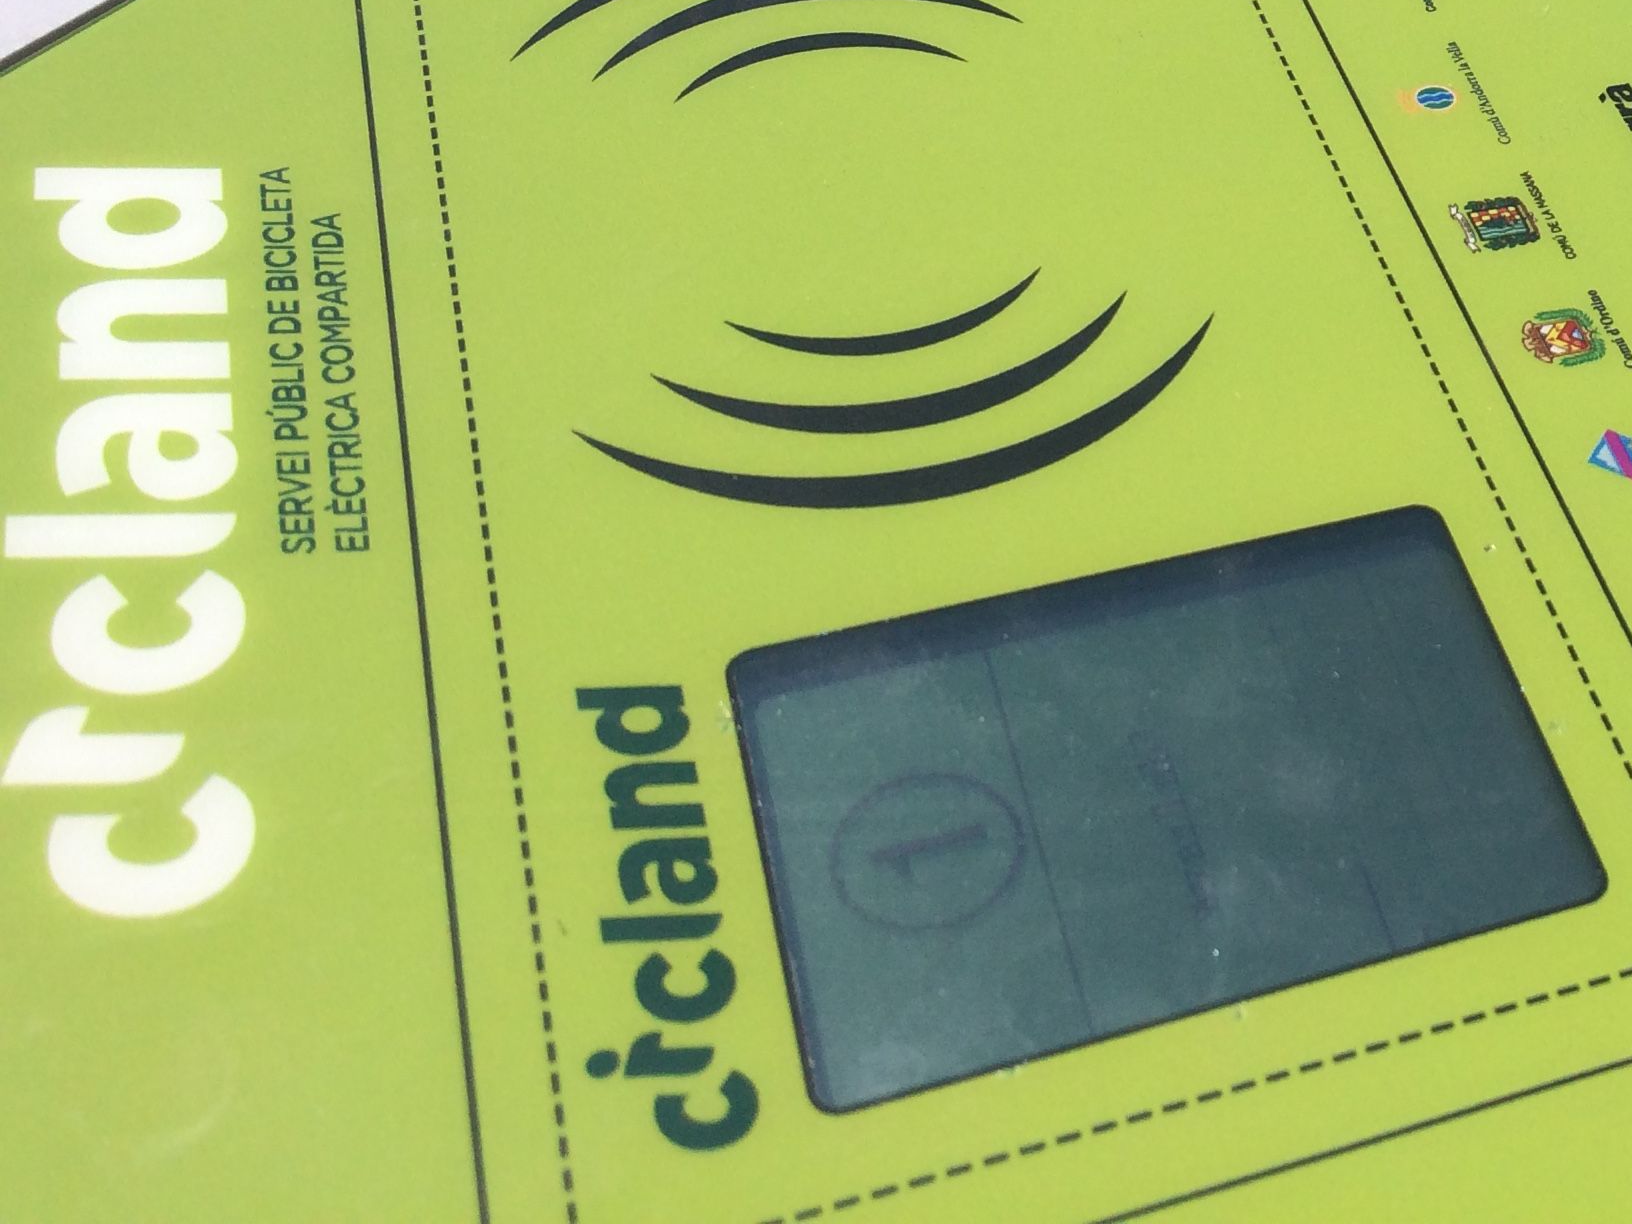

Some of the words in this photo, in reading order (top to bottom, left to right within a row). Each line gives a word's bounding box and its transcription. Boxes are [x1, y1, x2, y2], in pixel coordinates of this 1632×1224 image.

[1446, 41, 1464, 63] Vella
[1458, 62, 1471, 71] la
[1464, 72, 1496, 116] d'Andorra
[1487, 116, 1511, 145] Comú
[1519, 170, 1548, 209] MASSANA
[259, 166, 299, 292] BICICLETA
[1541, 209, 1555, 220] LA
[1547, 221, 1562, 233] DE
[1552, 235, 1577, 260] COMÚ
[267, 300, 302, 334] DE
[310, 213, 356, 384] COMPARTIDA
[1587, 289, 1620, 335] d'Ordino
[265, 342, 309, 440] PÚBLIC
[323, 392, 370, 552] ELÈCTRICA
[275, 451, 317, 554] SERVEI
